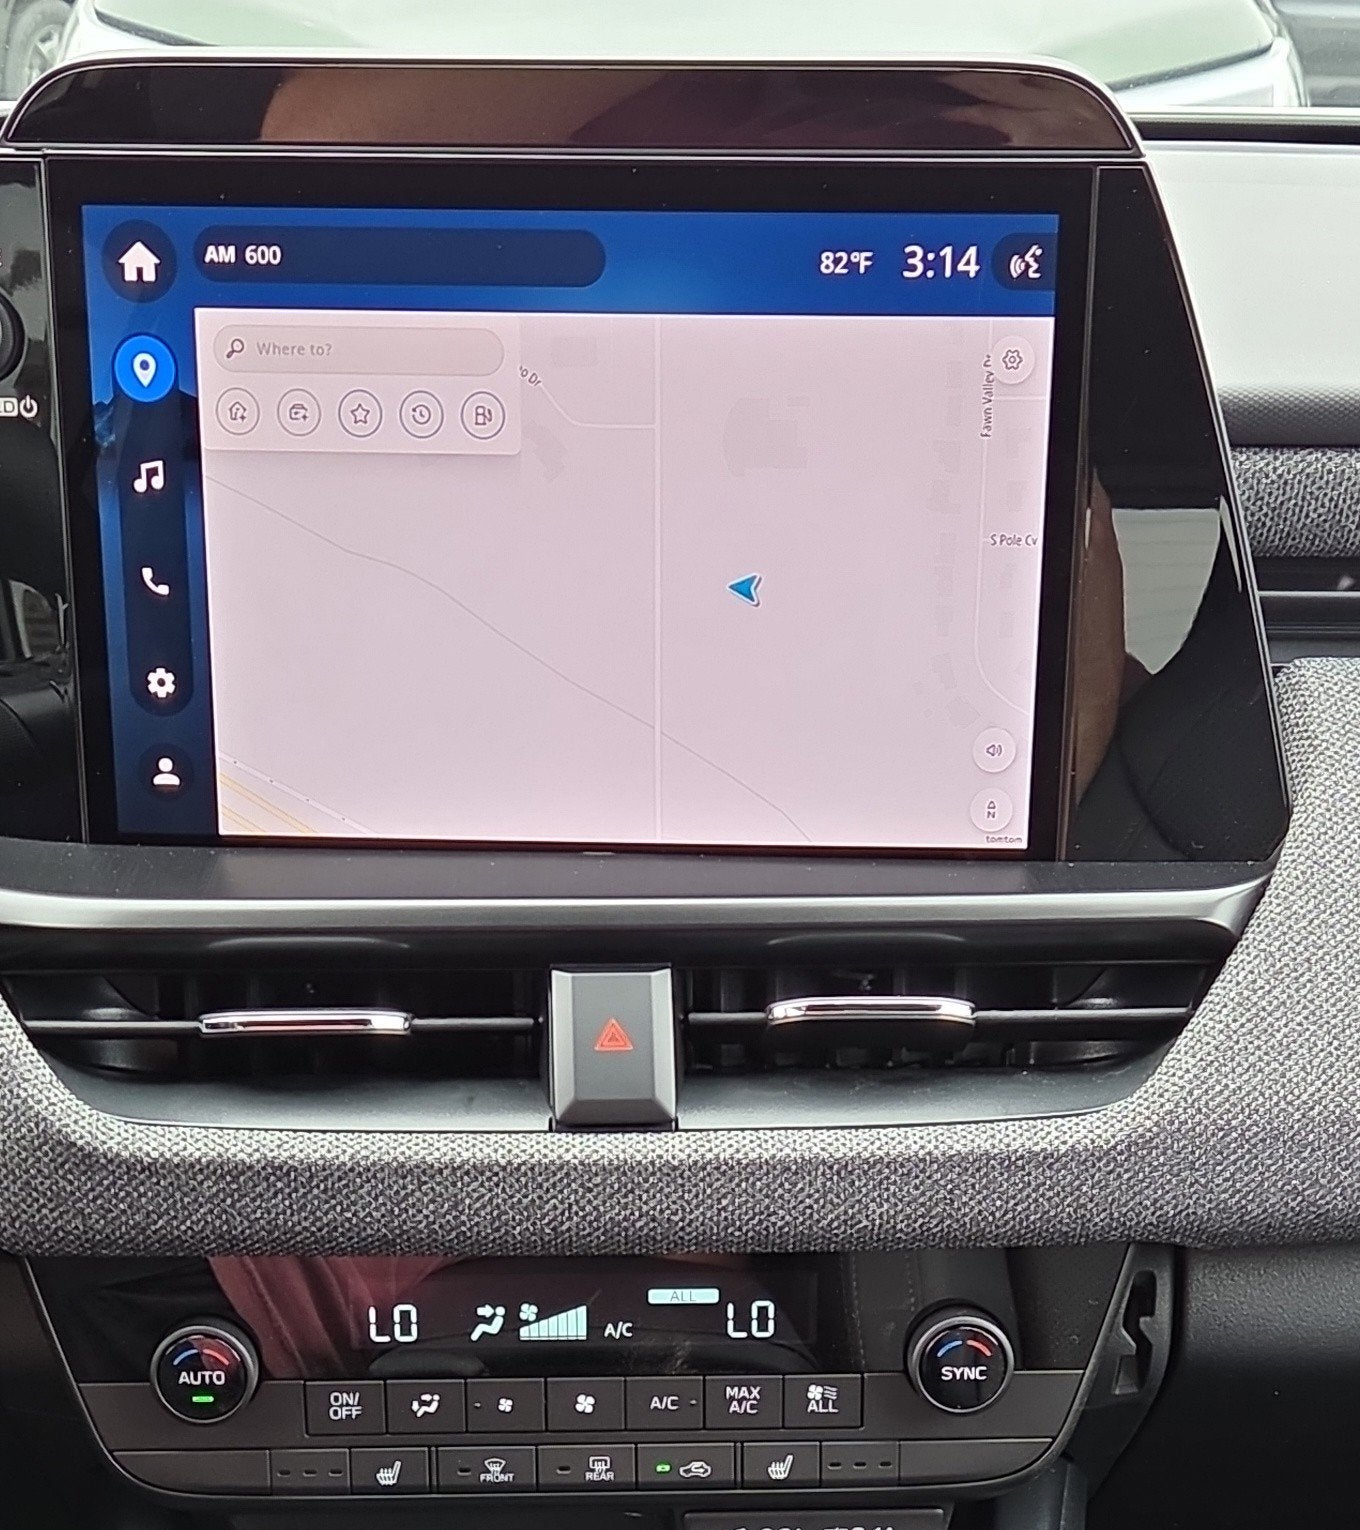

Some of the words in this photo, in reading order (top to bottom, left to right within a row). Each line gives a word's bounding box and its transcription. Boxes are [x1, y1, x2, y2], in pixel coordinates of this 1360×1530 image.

[204, 244, 236, 265] AM
[244, 244, 282, 266] 600
[819, 251, 874, 275] 82°F
[901, 245, 980, 279] 3:14
[255, 341, 306, 358] Where
[309, 341, 332, 358] to?
[528, 372, 542, 387] Dr
[982, 371, 995, 405] Valley
[990, 534, 998, 546] S
[999, 534, 1022, 546] Pole
[1024, 534, 1038, 546] Cv
[670, 1288, 697, 1303] ALL
[368, 1303, 419, 1343] LO
[726, 1300, 776, 1339] LO
[604, 1321, 634, 1339] A/C
[178, 1370, 226, 1386] AUTO
[940, 1366, 988, 1382] SYNC
[329, 1391, 360, 1407] ON/
[725, 1386, 761, 1400] MAX
[649, 1395, 679, 1411] A/C
[728, 1399, 759, 1415] A/C
[807, 1399, 839, 1414] ALL
[329, 1405, 362, 1420] OFF
[480, 1473, 515, 1483] FRONT
[585, 1472, 615, 1482] REAR
